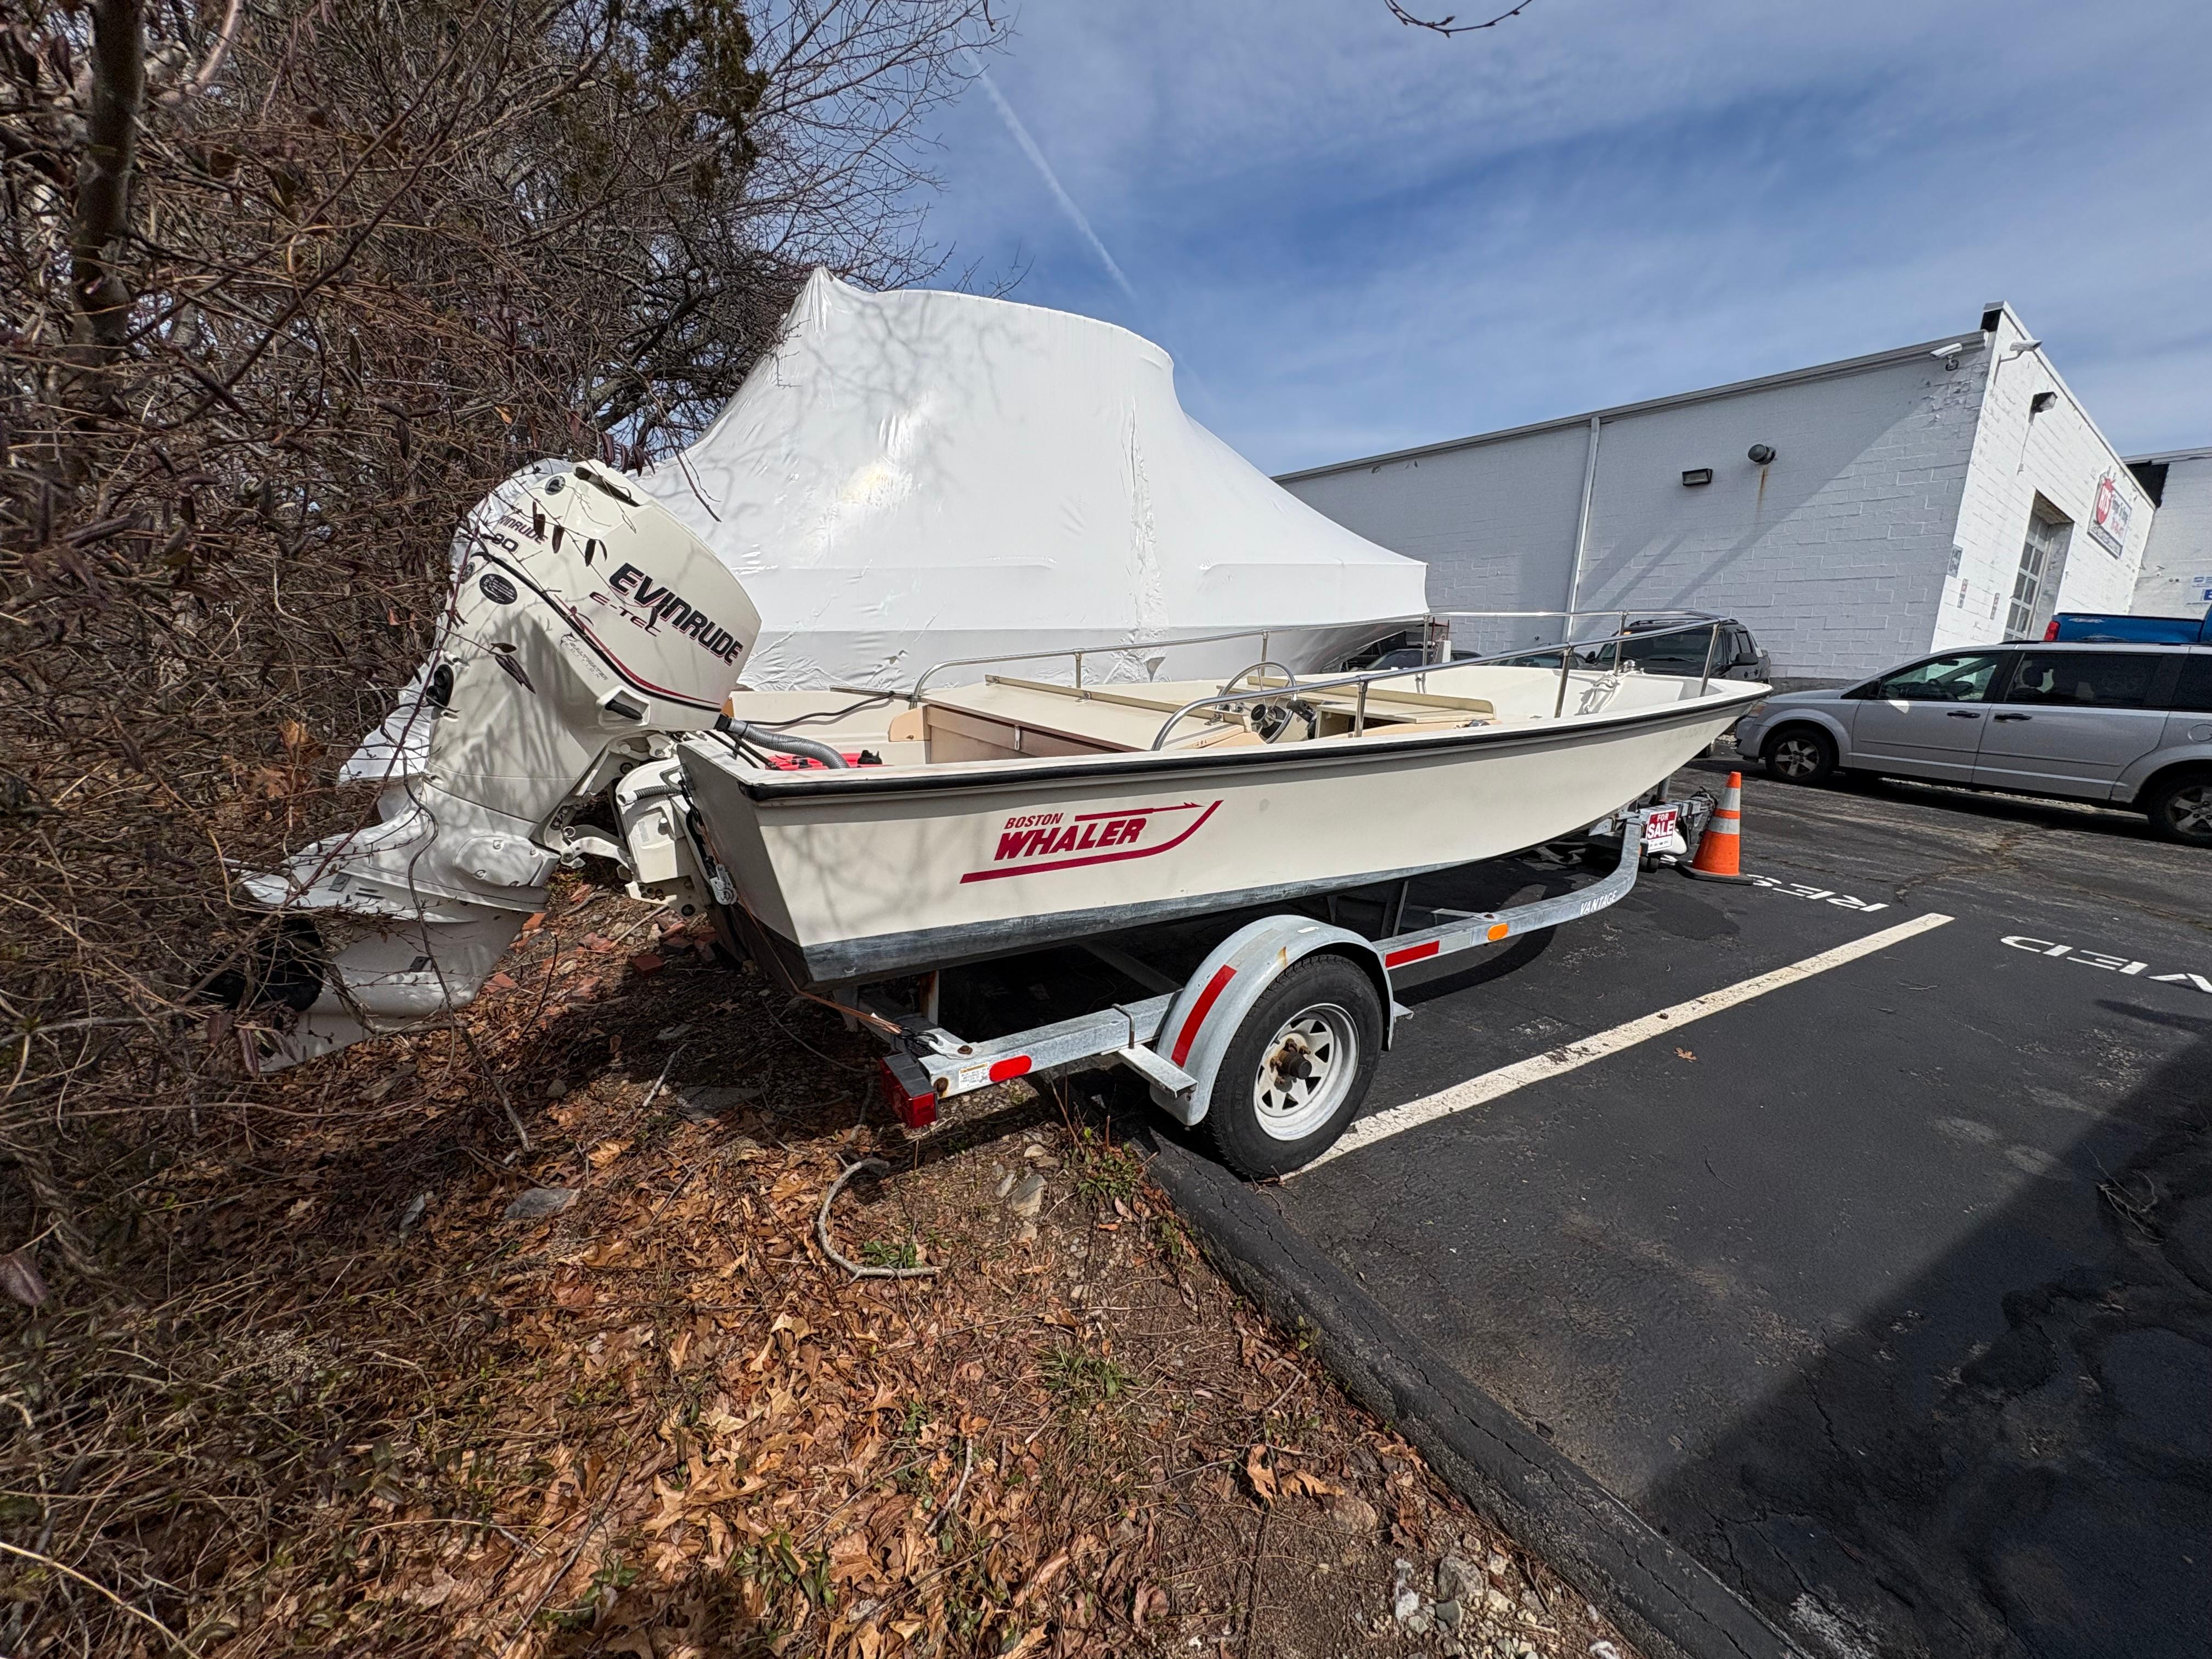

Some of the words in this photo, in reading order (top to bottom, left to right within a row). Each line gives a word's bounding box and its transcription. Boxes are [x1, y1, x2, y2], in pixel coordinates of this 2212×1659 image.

[589, 591, 662, 637] E-TEC
[609, 562, 743, 666] EVINRUDE
[1004, 812, 1064, 830] BOSTON
[1647, 820, 1675, 839] SALE
[1657, 813, 1669, 822] FOR
[994, 818, 1147, 861] WHALER
[1580, 890, 1617, 916] VANTAGE
